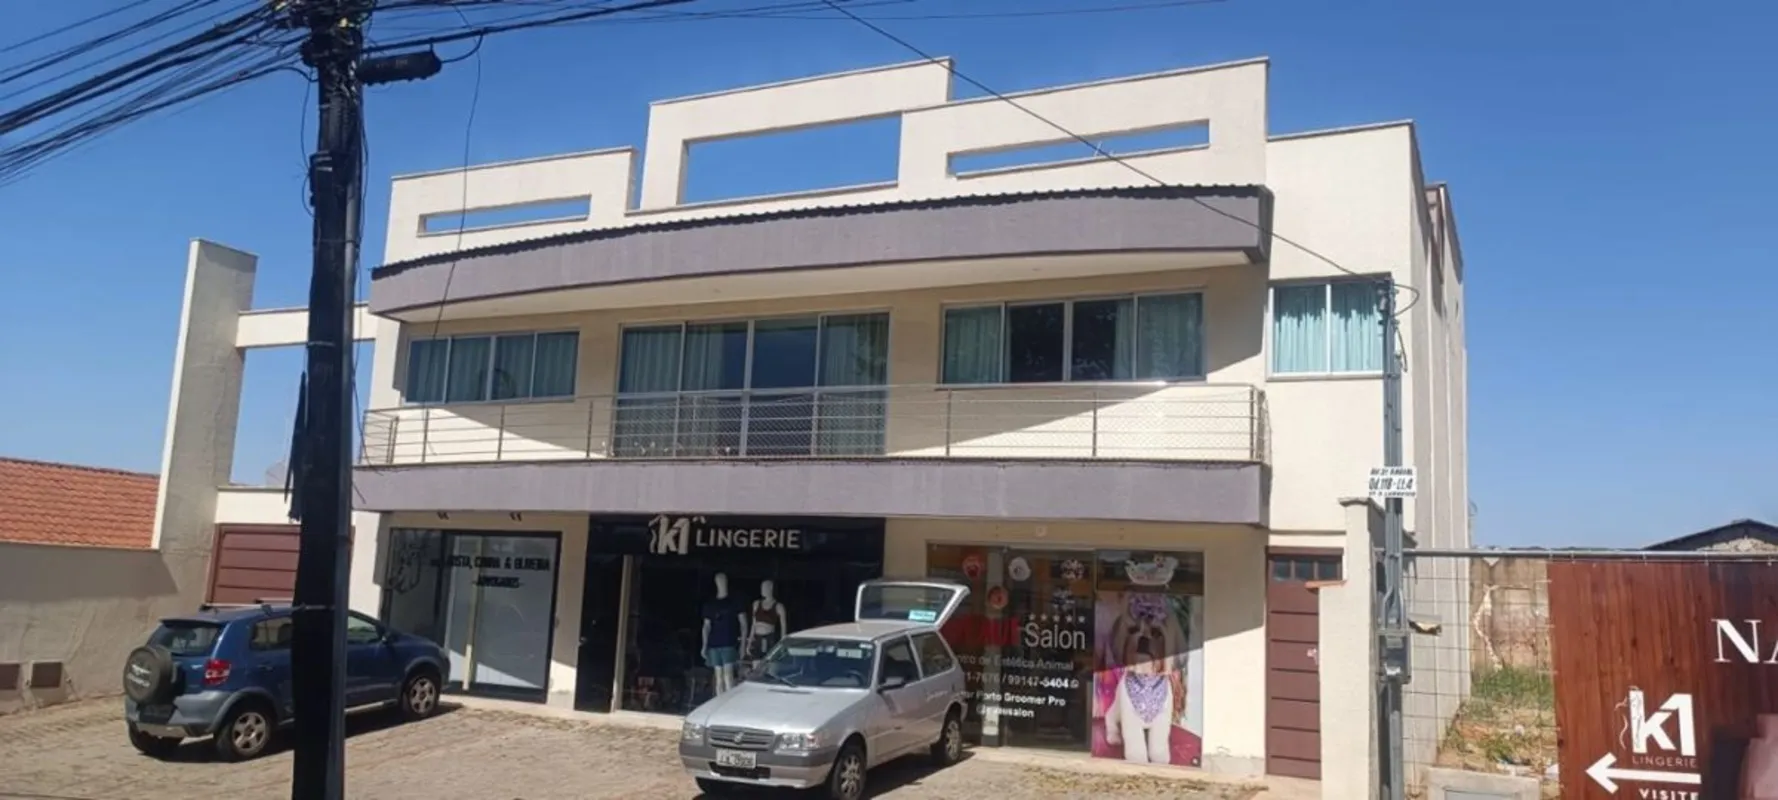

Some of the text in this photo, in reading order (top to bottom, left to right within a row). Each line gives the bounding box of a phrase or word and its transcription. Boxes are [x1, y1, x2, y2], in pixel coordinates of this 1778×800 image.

[695, 528, 801, 549] LINGERIE
[1024, 621, 1085, 649] Salon
[1037, 658, 1075, 672] Animal
[1004, 692, 1046, 706] Groomer
[1048, 695, 1067, 707] Pro
[1632, 755, 1698, 769] LINGERIE
